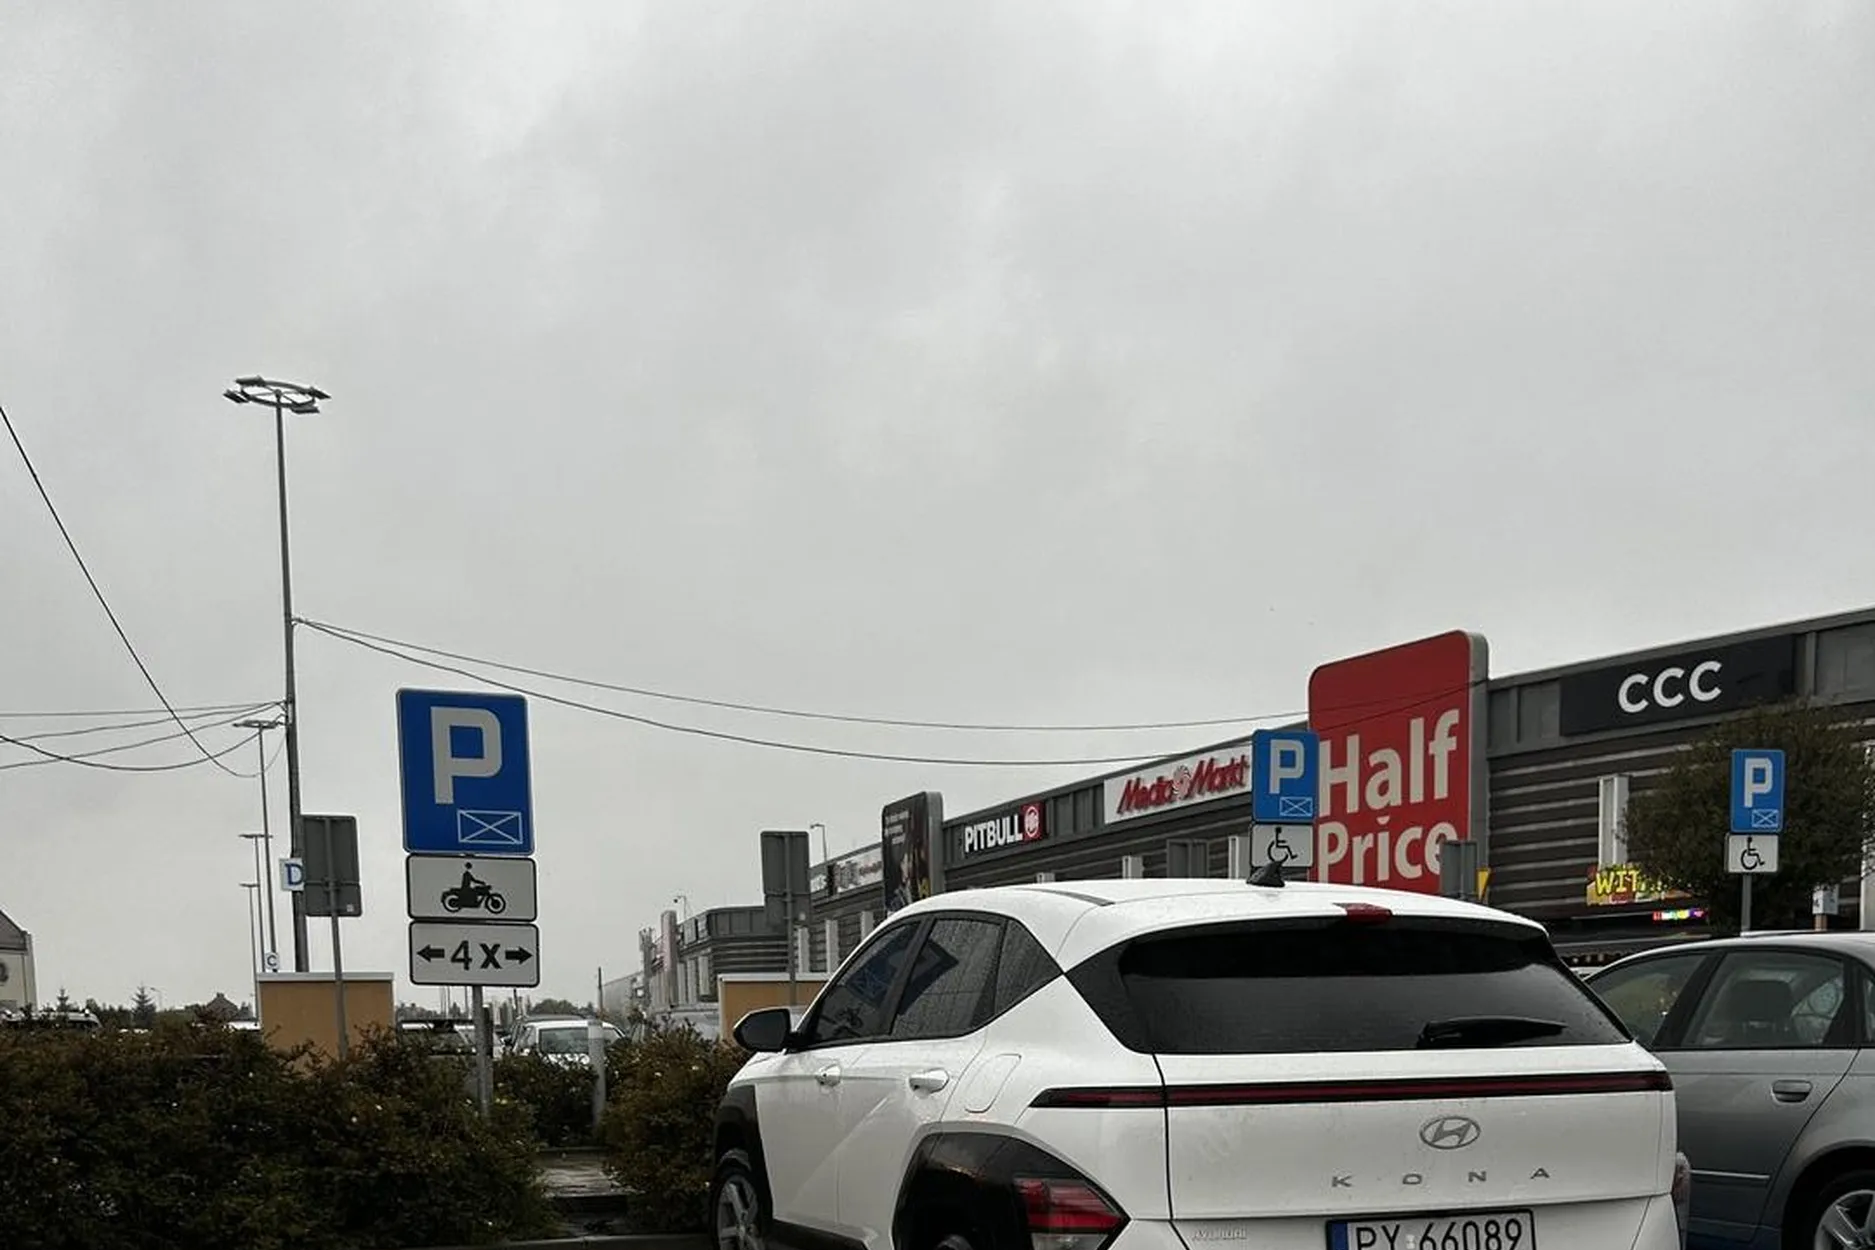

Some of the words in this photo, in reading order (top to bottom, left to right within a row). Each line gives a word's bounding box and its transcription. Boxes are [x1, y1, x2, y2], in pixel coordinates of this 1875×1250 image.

[1618, 660, 1723, 714] CCC
[430, 706, 501, 804] P
[1269, 739, 1305, 795] P
[1319, 709, 1460, 818] Half
[1117, 776, 1174, 815] Media
[1744, 757, 1773, 808] P
[964, 813, 1023, 853] PITBULL
[1318, 820, 1459, 886] Price
[284, 863, 305, 885] D
[267, 954, 278, 967] C
[1331, 1167, 1550, 1188] KONA
